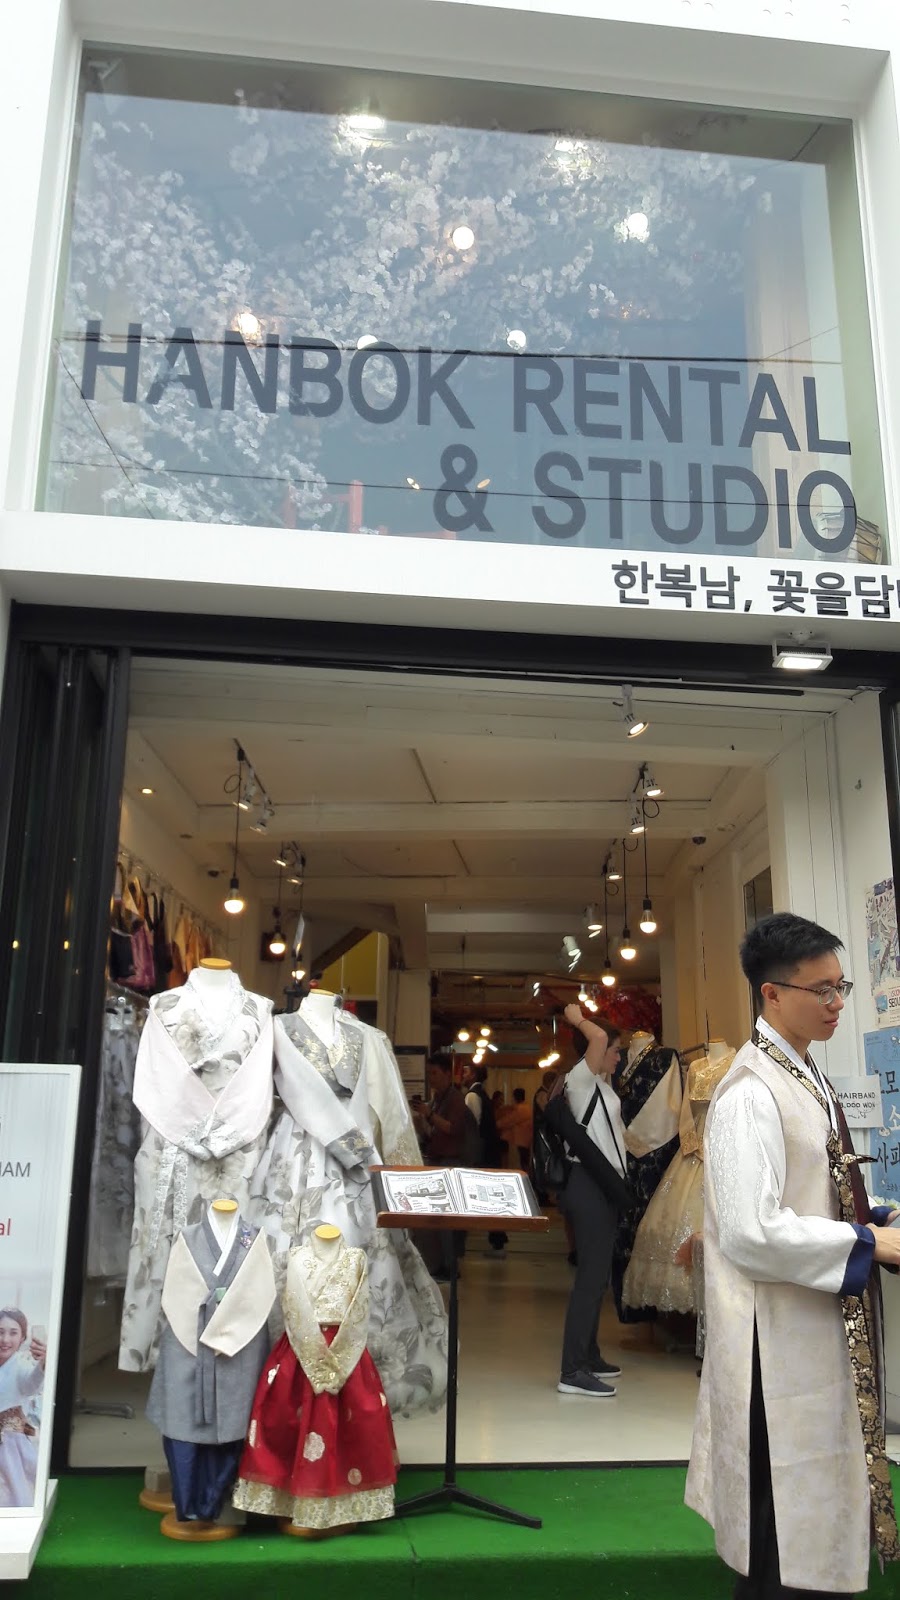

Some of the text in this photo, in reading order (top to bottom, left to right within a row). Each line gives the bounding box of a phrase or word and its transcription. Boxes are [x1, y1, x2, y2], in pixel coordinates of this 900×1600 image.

[80, 319, 851, 456] HANBOK RENTAL
[432, 443, 858, 554] & STUDIO
[611, 559, 900, 619] 한복남, 꽃을담
[837, 1091, 876, 1100] HAIRBAND
